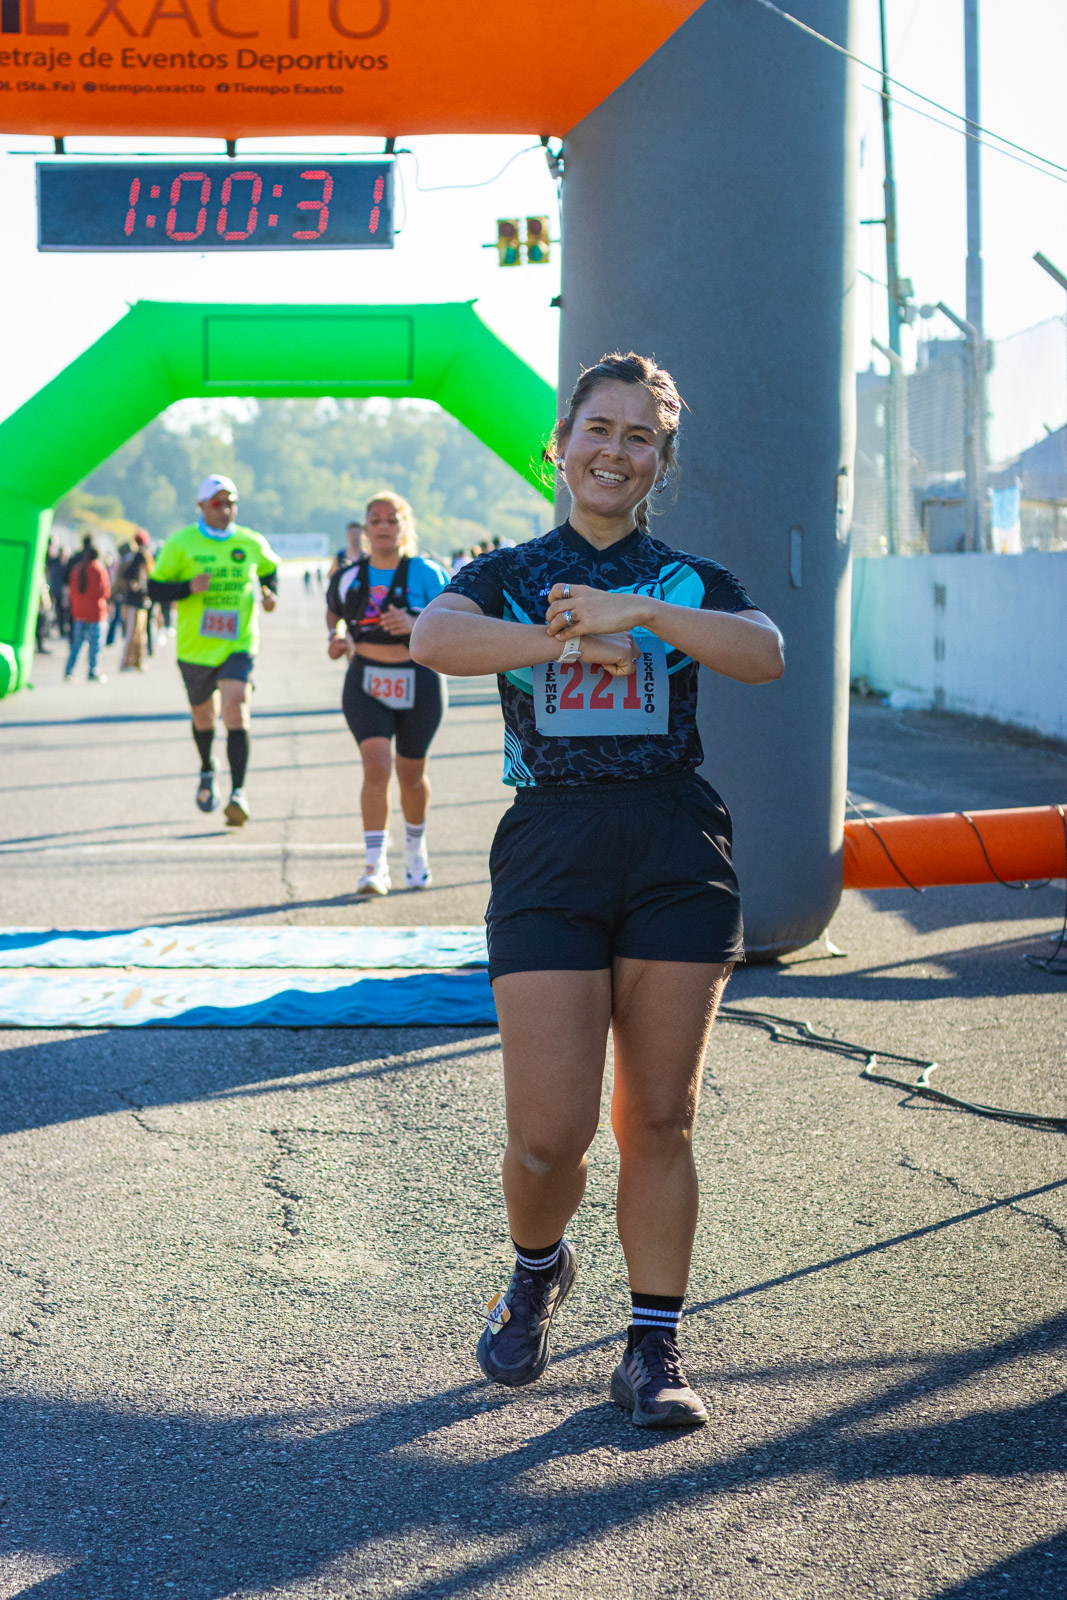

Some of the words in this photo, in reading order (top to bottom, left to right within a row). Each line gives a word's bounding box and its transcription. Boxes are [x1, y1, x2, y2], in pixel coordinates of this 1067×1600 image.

[79, 47, 113, 68] de
[121, 48, 229, 69] Eventos
[237, 49, 388, 74] Deportivos
[233, 82, 290, 95] Tiempo
[294, 84, 344, 94] Exacto
[371, 676, 404, 698] 236
[545, 661, 557, 714] IEMPO
[560, 660, 641, 710] 221
[643, 652, 655, 713] EXACTO
